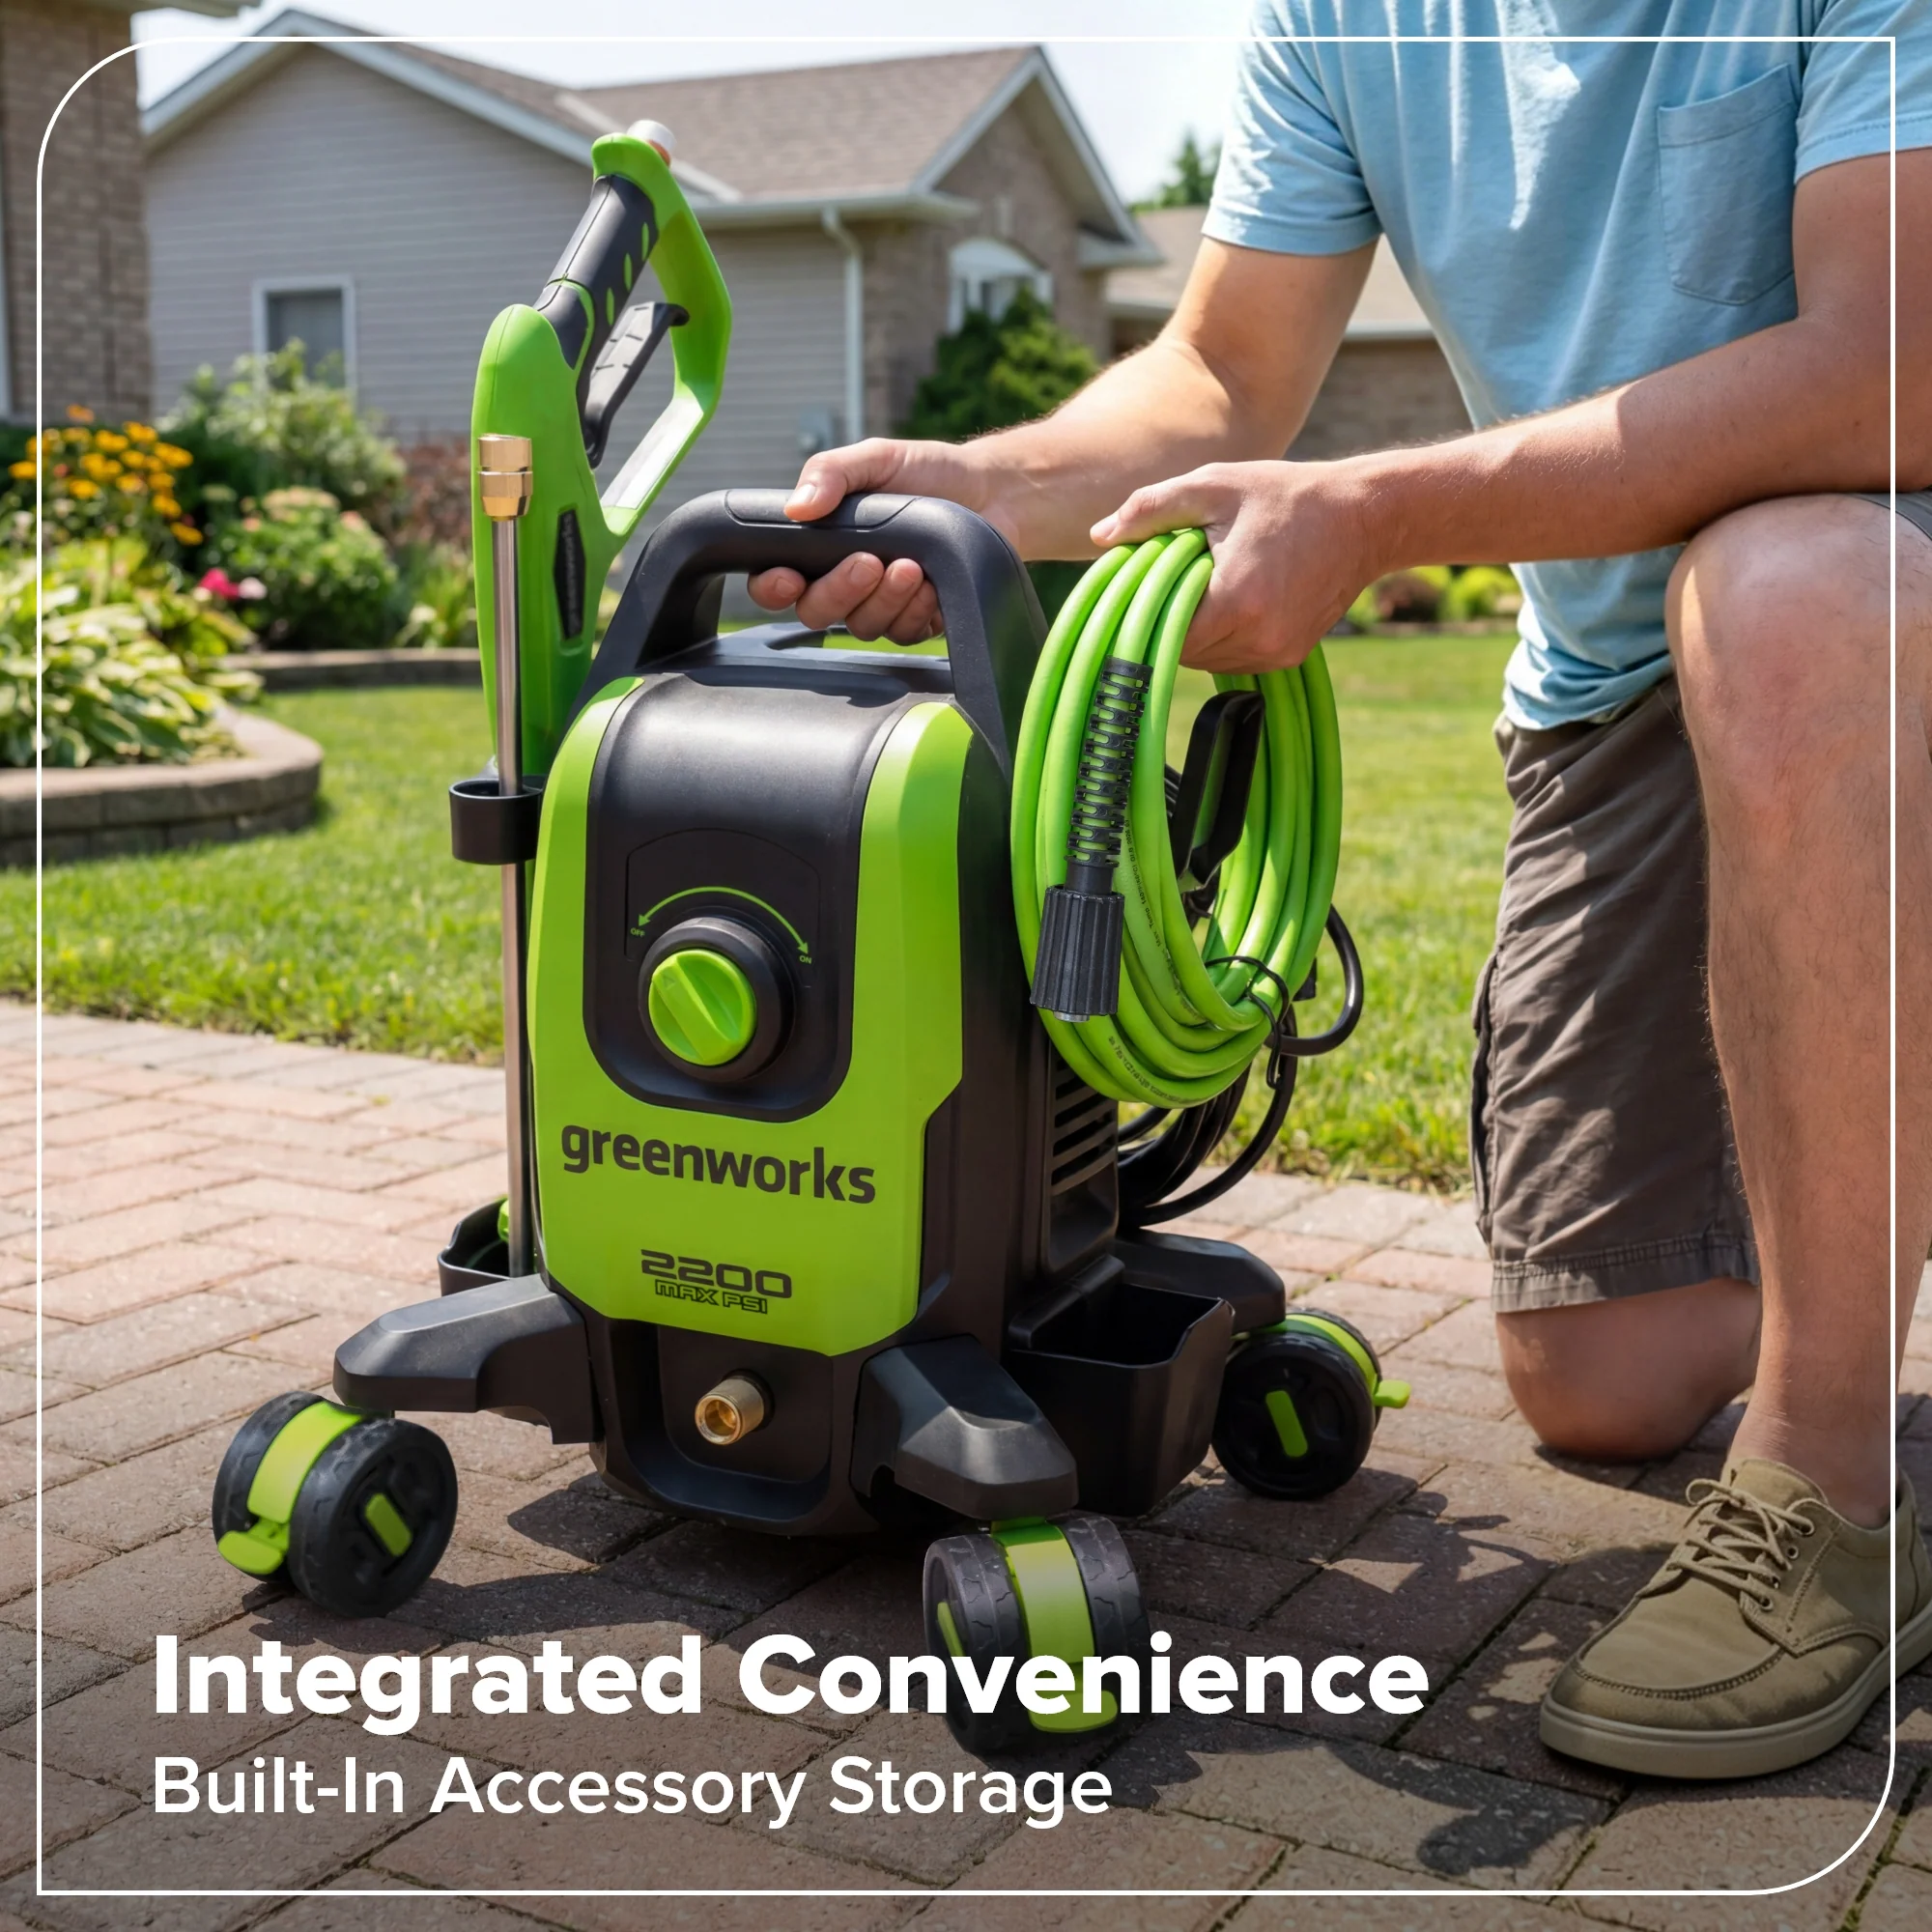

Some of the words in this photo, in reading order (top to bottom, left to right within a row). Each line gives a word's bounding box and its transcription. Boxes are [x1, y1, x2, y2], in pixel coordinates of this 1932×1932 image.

[630, 927, 645, 937] OFF
[799, 954, 812, 964] ON
[561, 1124, 876, 1205] greenworks
[640, 1249, 792, 1298] 2200
[655, 1279, 719, 1306] MAX
[723, 1291, 768, 1315] PSI
